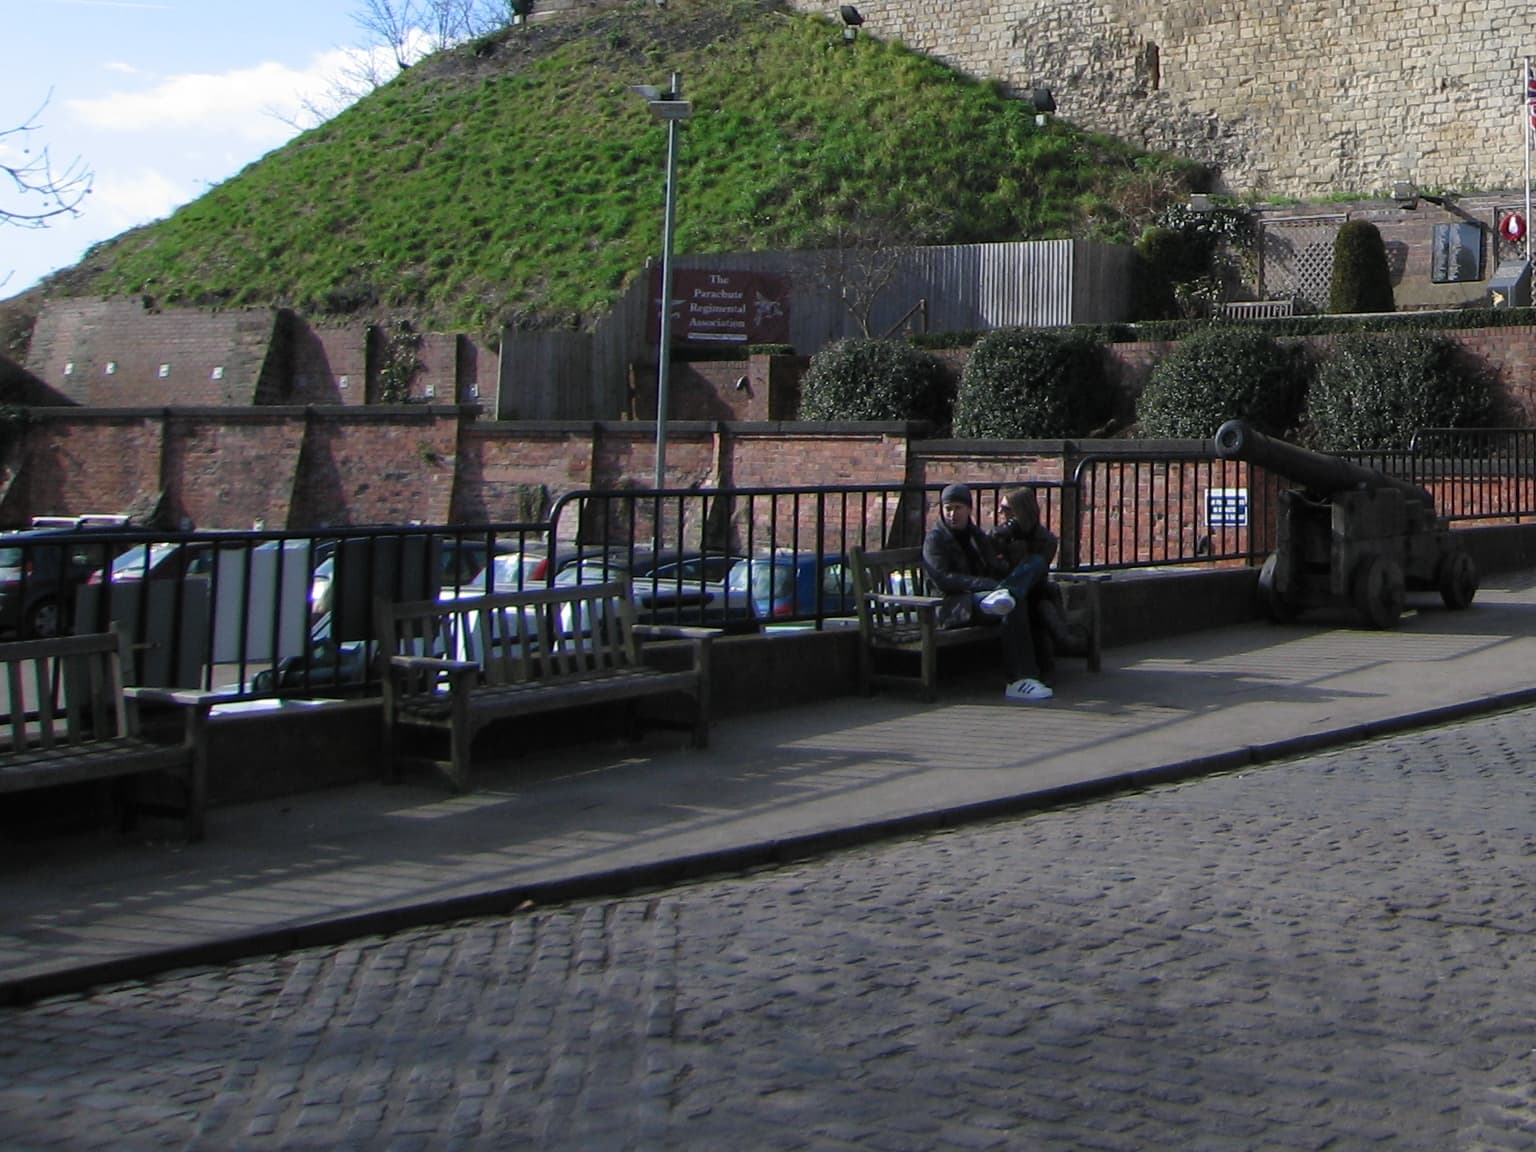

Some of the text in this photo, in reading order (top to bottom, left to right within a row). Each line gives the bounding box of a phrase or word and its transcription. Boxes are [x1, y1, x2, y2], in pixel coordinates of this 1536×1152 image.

[709, 274, 729, 285] The
[693, 288, 744, 299] Parachute
[690, 303, 746, 315] Regimental
[689, 317, 745, 328] Association
